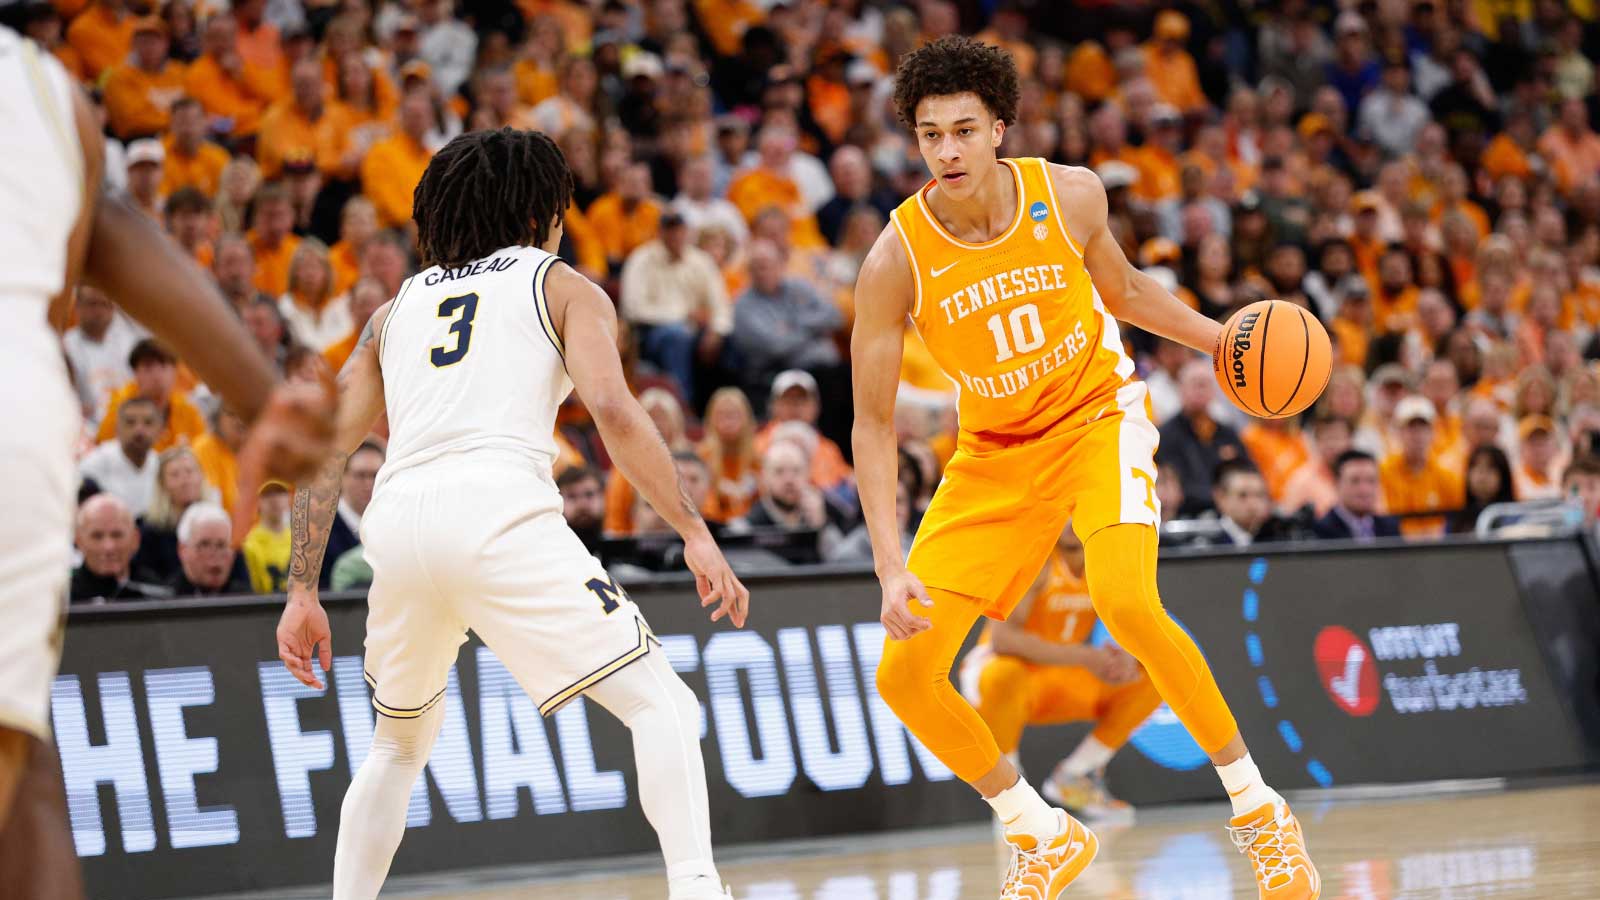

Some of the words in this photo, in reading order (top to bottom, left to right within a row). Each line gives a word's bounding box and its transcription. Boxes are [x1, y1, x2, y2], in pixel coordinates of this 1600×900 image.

[424, 256, 519, 287] CADEAU
[939, 264, 1067, 325] TENNESSEE
[429, 289, 481, 369] 3
[960, 320, 1088, 399] VOLUNTEERS
[986, 303, 1047, 363] 10
[1232, 311, 1262, 388] Wilson
[50, 665, 240, 857] HE
[659, 621, 956, 799] OUR
